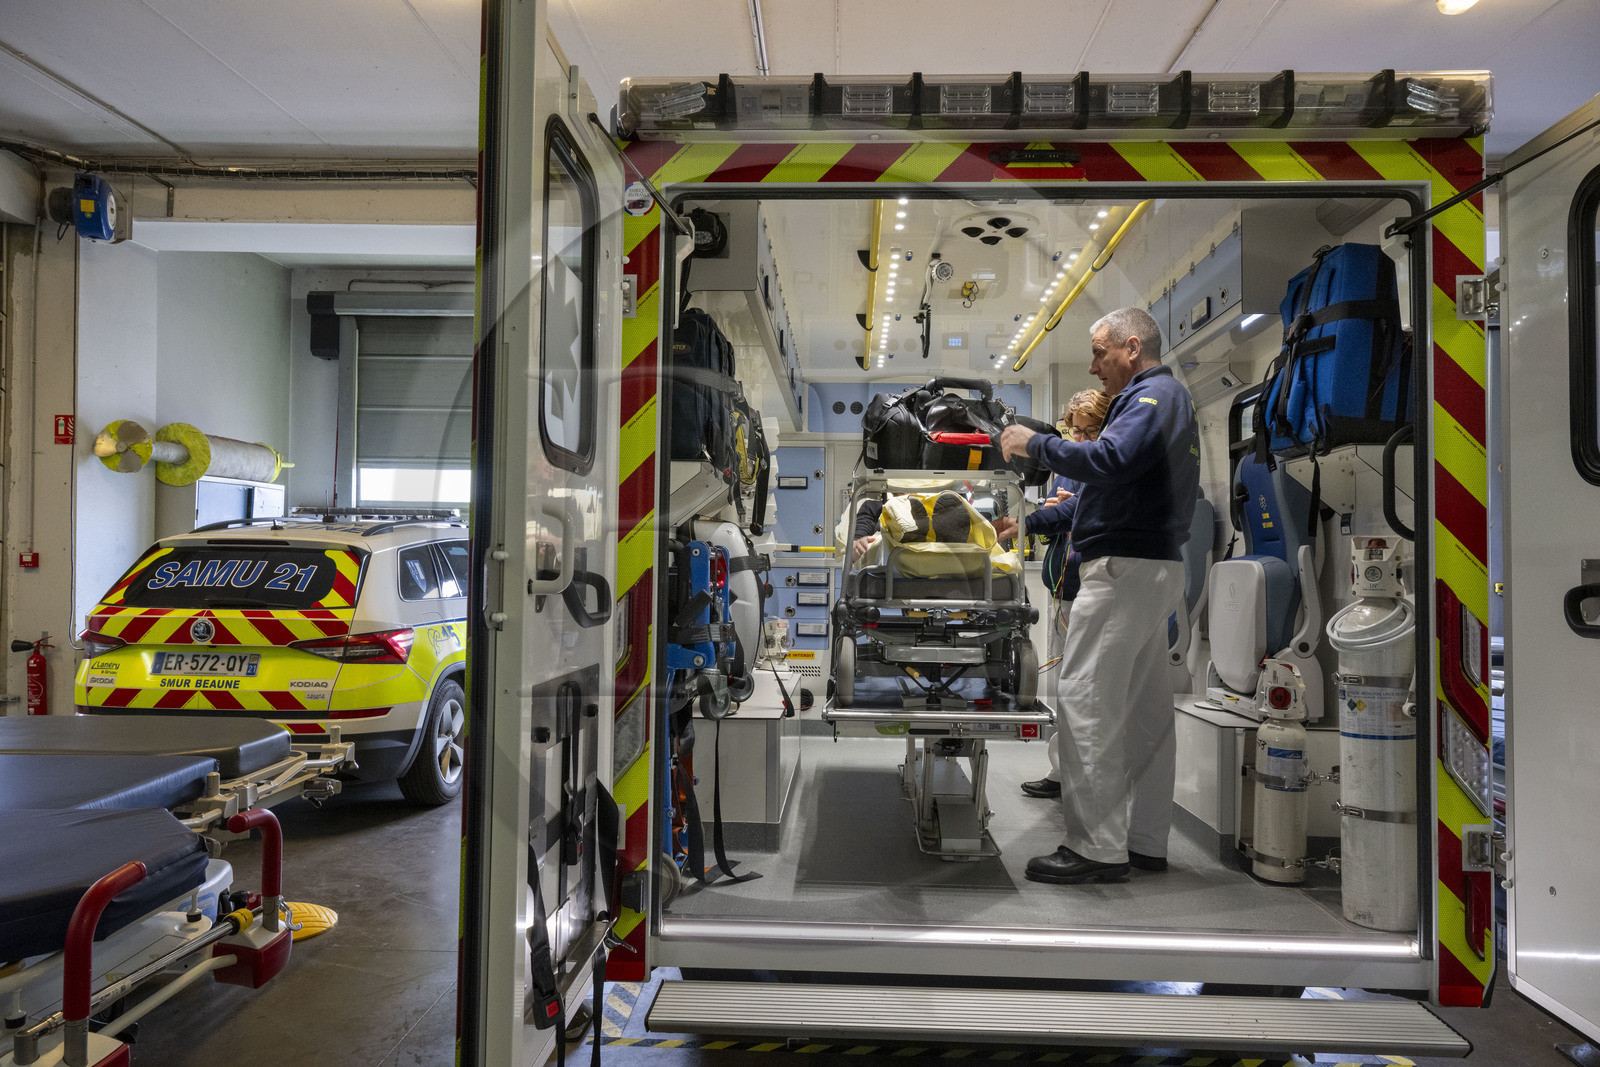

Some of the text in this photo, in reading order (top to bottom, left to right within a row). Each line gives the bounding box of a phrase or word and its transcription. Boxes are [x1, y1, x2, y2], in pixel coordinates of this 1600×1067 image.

[147, 560, 318, 593] SAMU 21
[164, 653, 248, 672] ER-572-QY
[159, 678, 241, 689] SMUR BEAUNE
